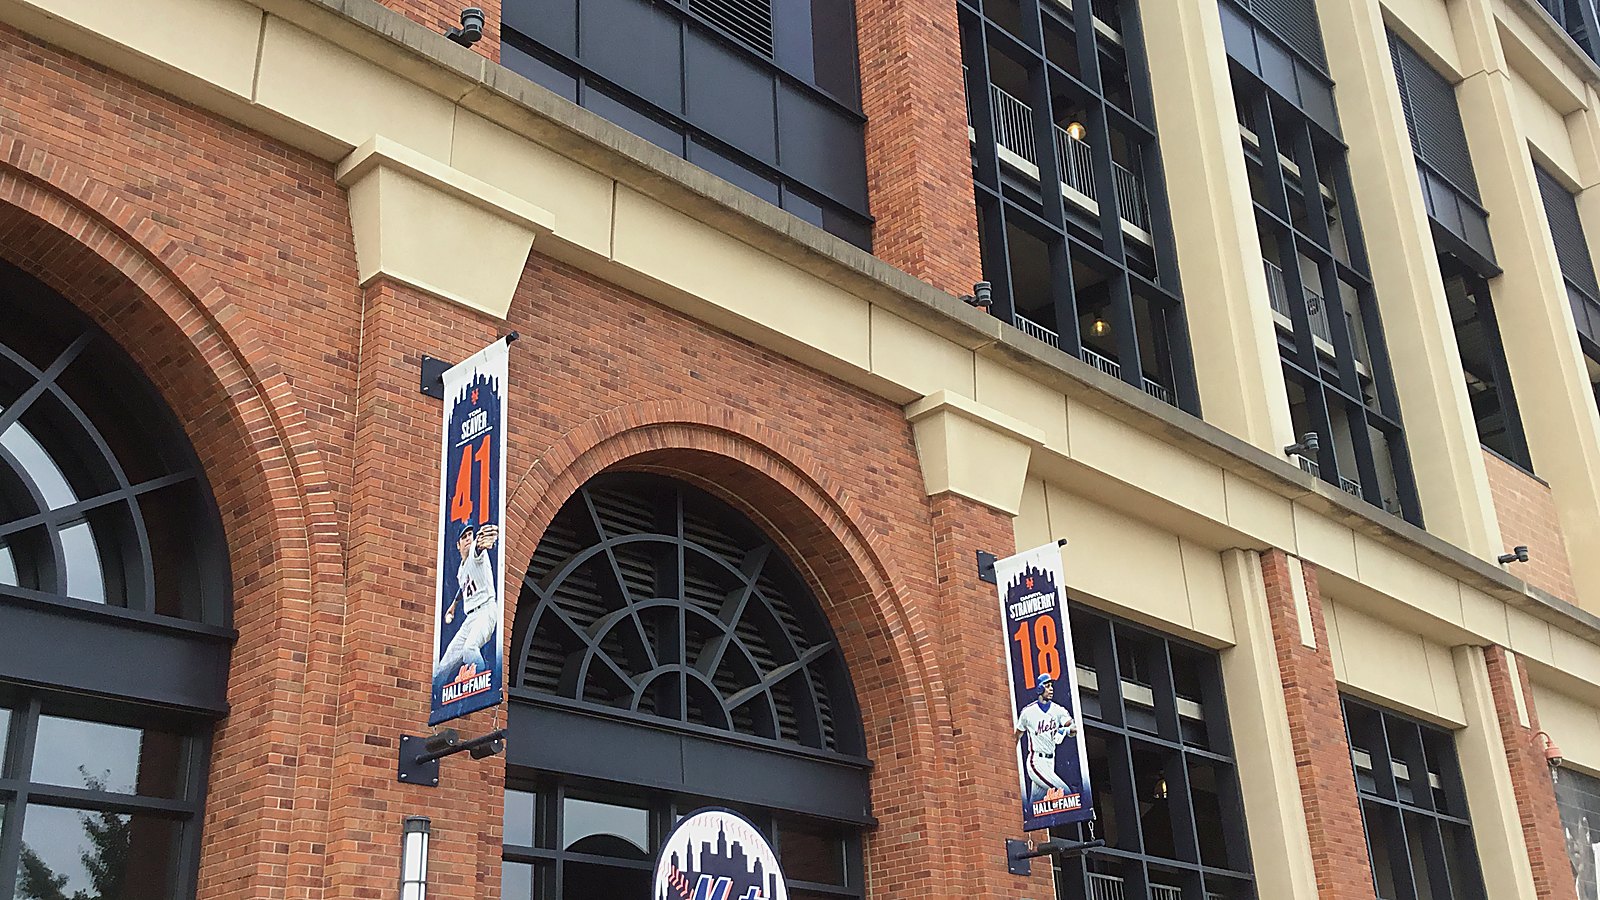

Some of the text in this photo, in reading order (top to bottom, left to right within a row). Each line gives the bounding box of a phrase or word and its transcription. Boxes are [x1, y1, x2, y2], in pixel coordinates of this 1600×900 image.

[461, 410, 488, 440] SEAVER
[468, 407, 482, 418] TOM
[451, 434, 491, 525] 41
[1010, 591, 1056, 619] STRAWBERRY
[1014, 614, 1061, 690] 18
[442, 683, 463, 703] HALL
[468, 672, 492, 694] FAME
[1035, 718, 1057, 736] Mets
[1033, 801, 1054, 815] HALL
[1058, 795, 1082, 810] FAME
